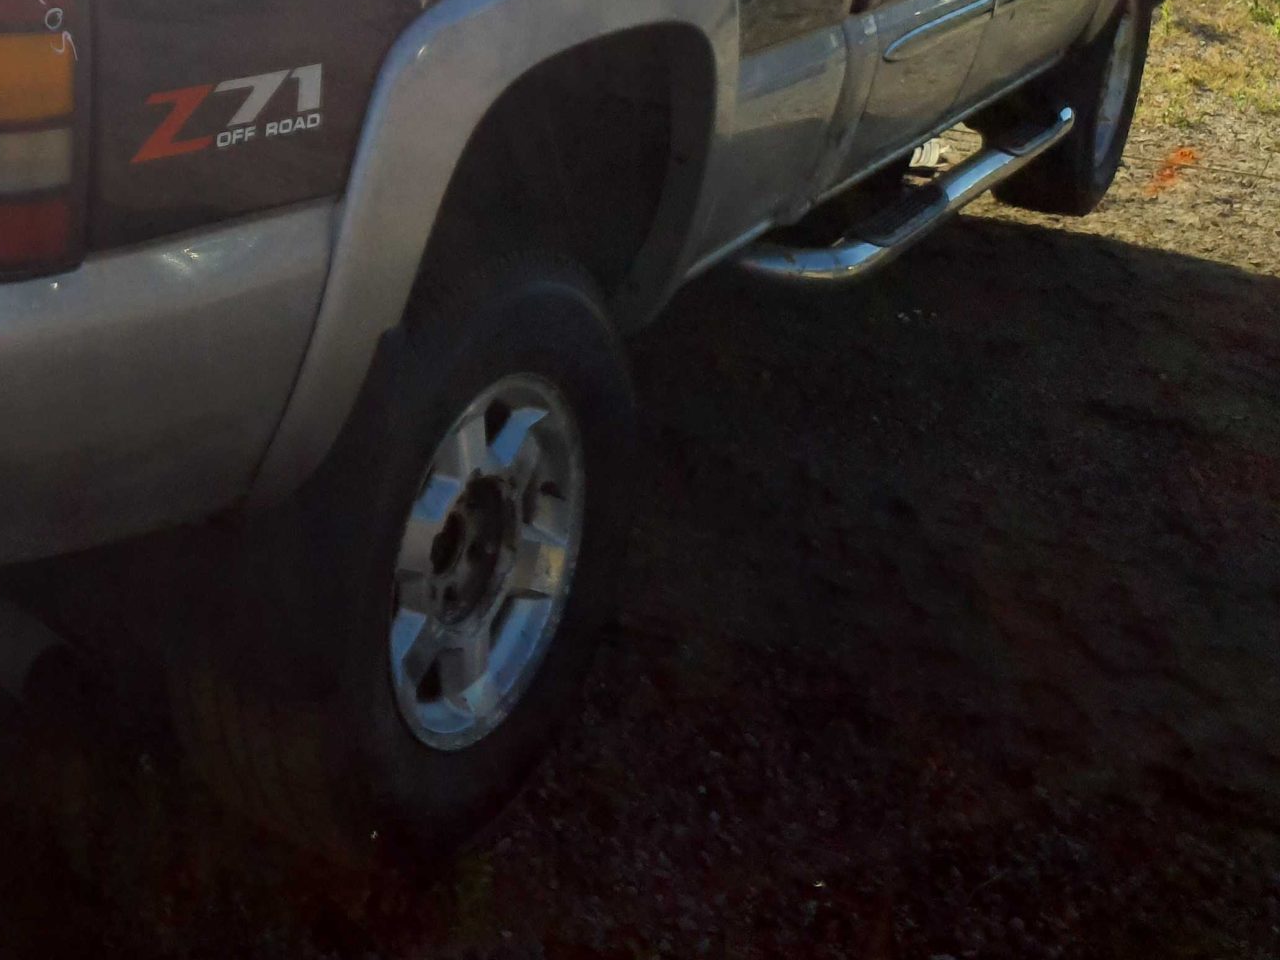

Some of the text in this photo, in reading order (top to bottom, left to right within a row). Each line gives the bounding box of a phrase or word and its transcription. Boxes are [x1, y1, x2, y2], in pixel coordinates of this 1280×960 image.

[129, 63, 323, 163] Z71
[216, 113, 321, 148] OFF ROAD
